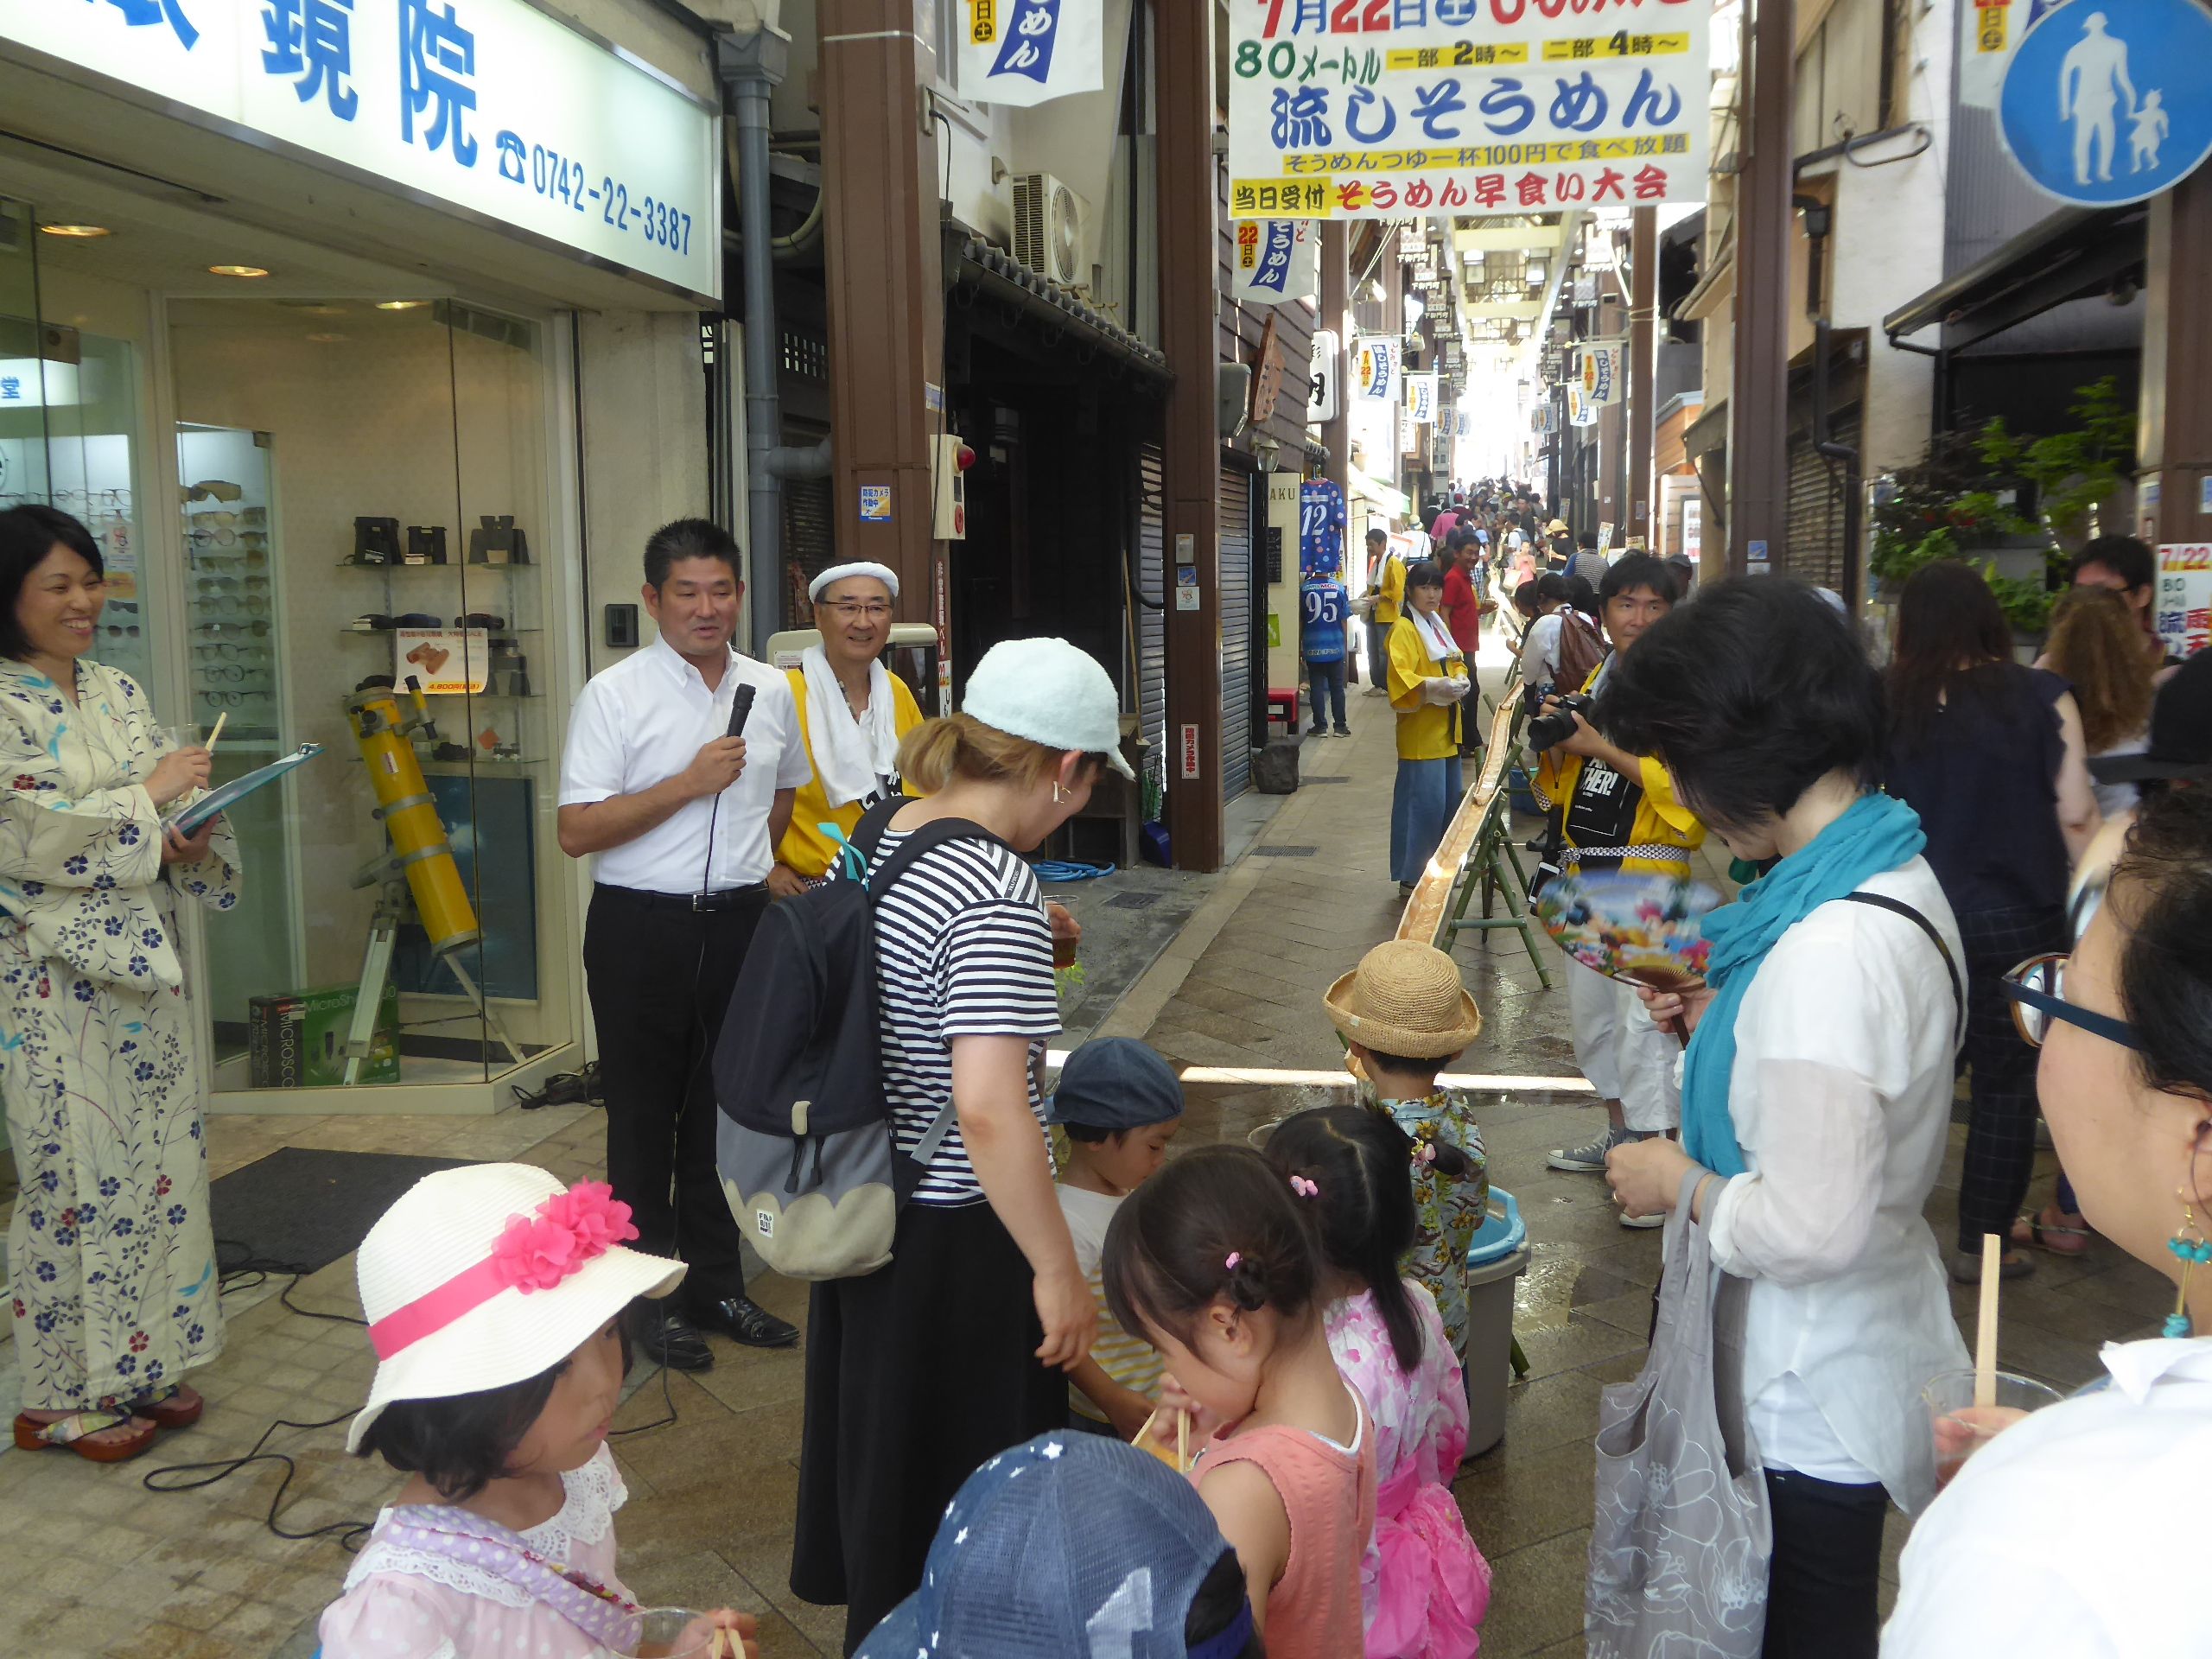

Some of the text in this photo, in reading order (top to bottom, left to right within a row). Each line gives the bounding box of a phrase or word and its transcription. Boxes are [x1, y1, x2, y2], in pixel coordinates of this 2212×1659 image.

[1003, 0, 1052, 69] めん
[1235, 40, 1380, 85] 80メートル
[1394, 48, 1439, 67] 一部
[1548, 38, 1595, 59] 二部
[1270, 67, 1681, 149] 流しそうめん
[532, 143, 690, 255] 0742-22-3387
[1236, 163, 1668, 211] 当日受付 そうめん早食い大会
[1301, 505, 1327, 537] 12
[1306, 591, 1338, 624] 95
